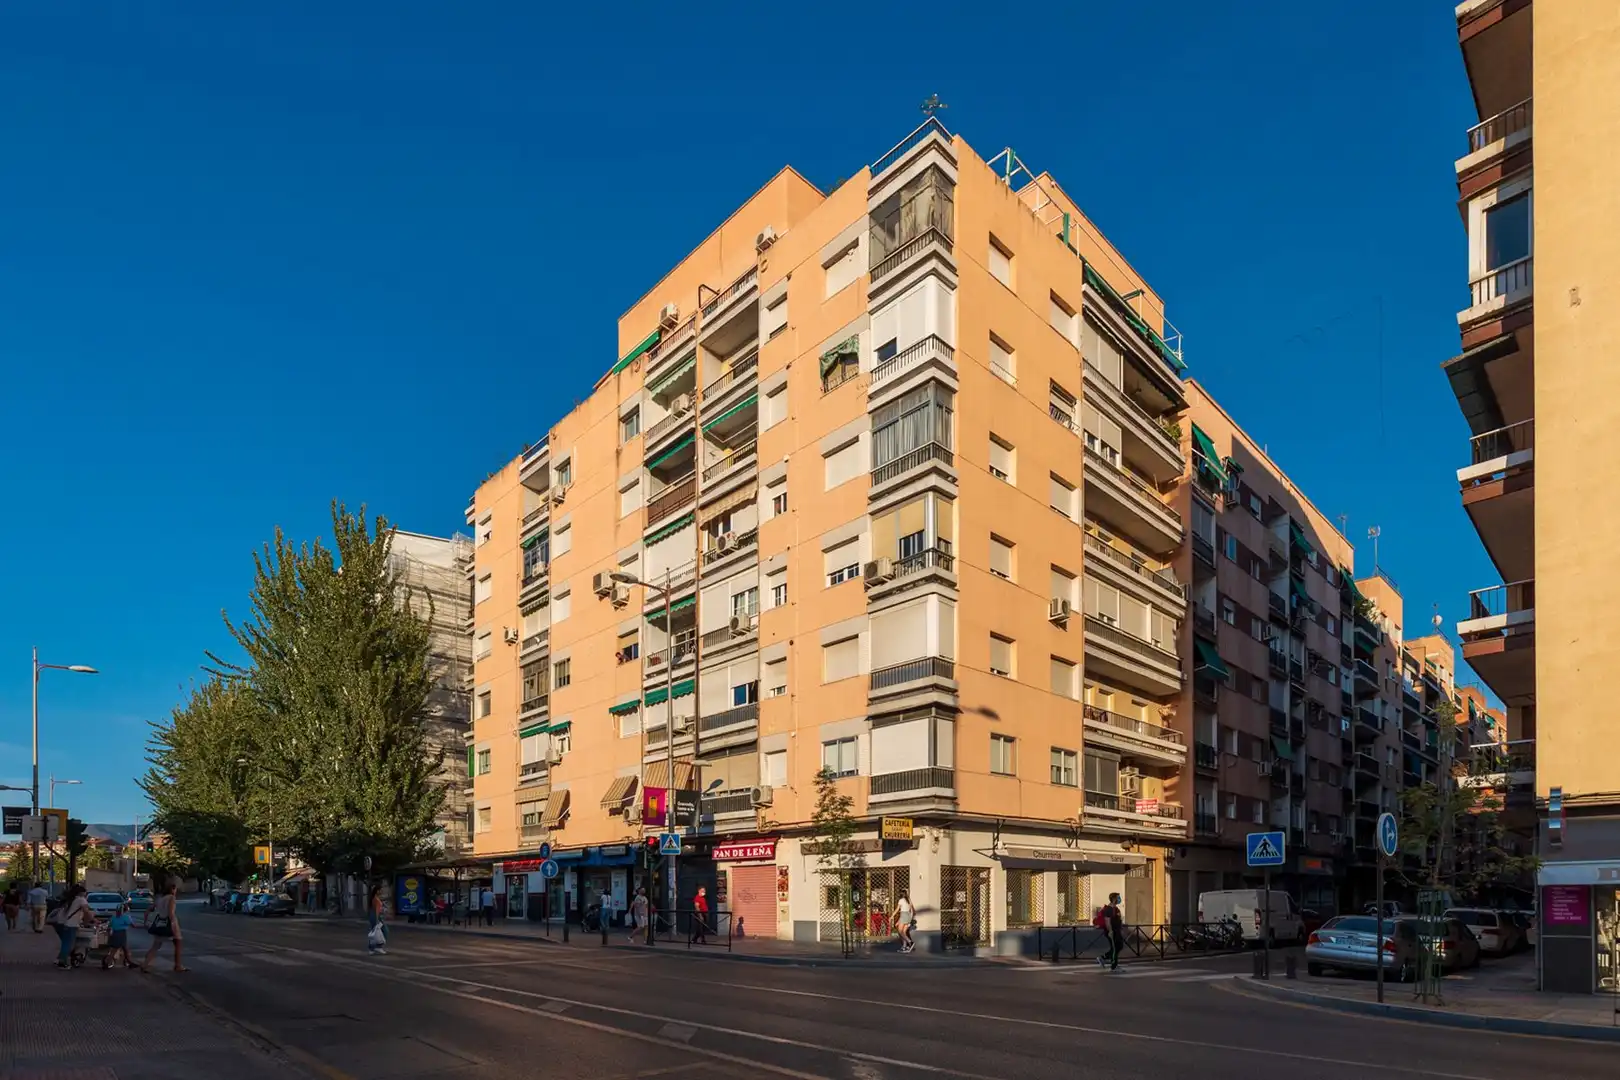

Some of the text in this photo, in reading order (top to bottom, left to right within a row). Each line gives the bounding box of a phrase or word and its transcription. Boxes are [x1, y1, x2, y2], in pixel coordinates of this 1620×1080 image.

[713, 845, 772, 858] PAN DE LEÑA
